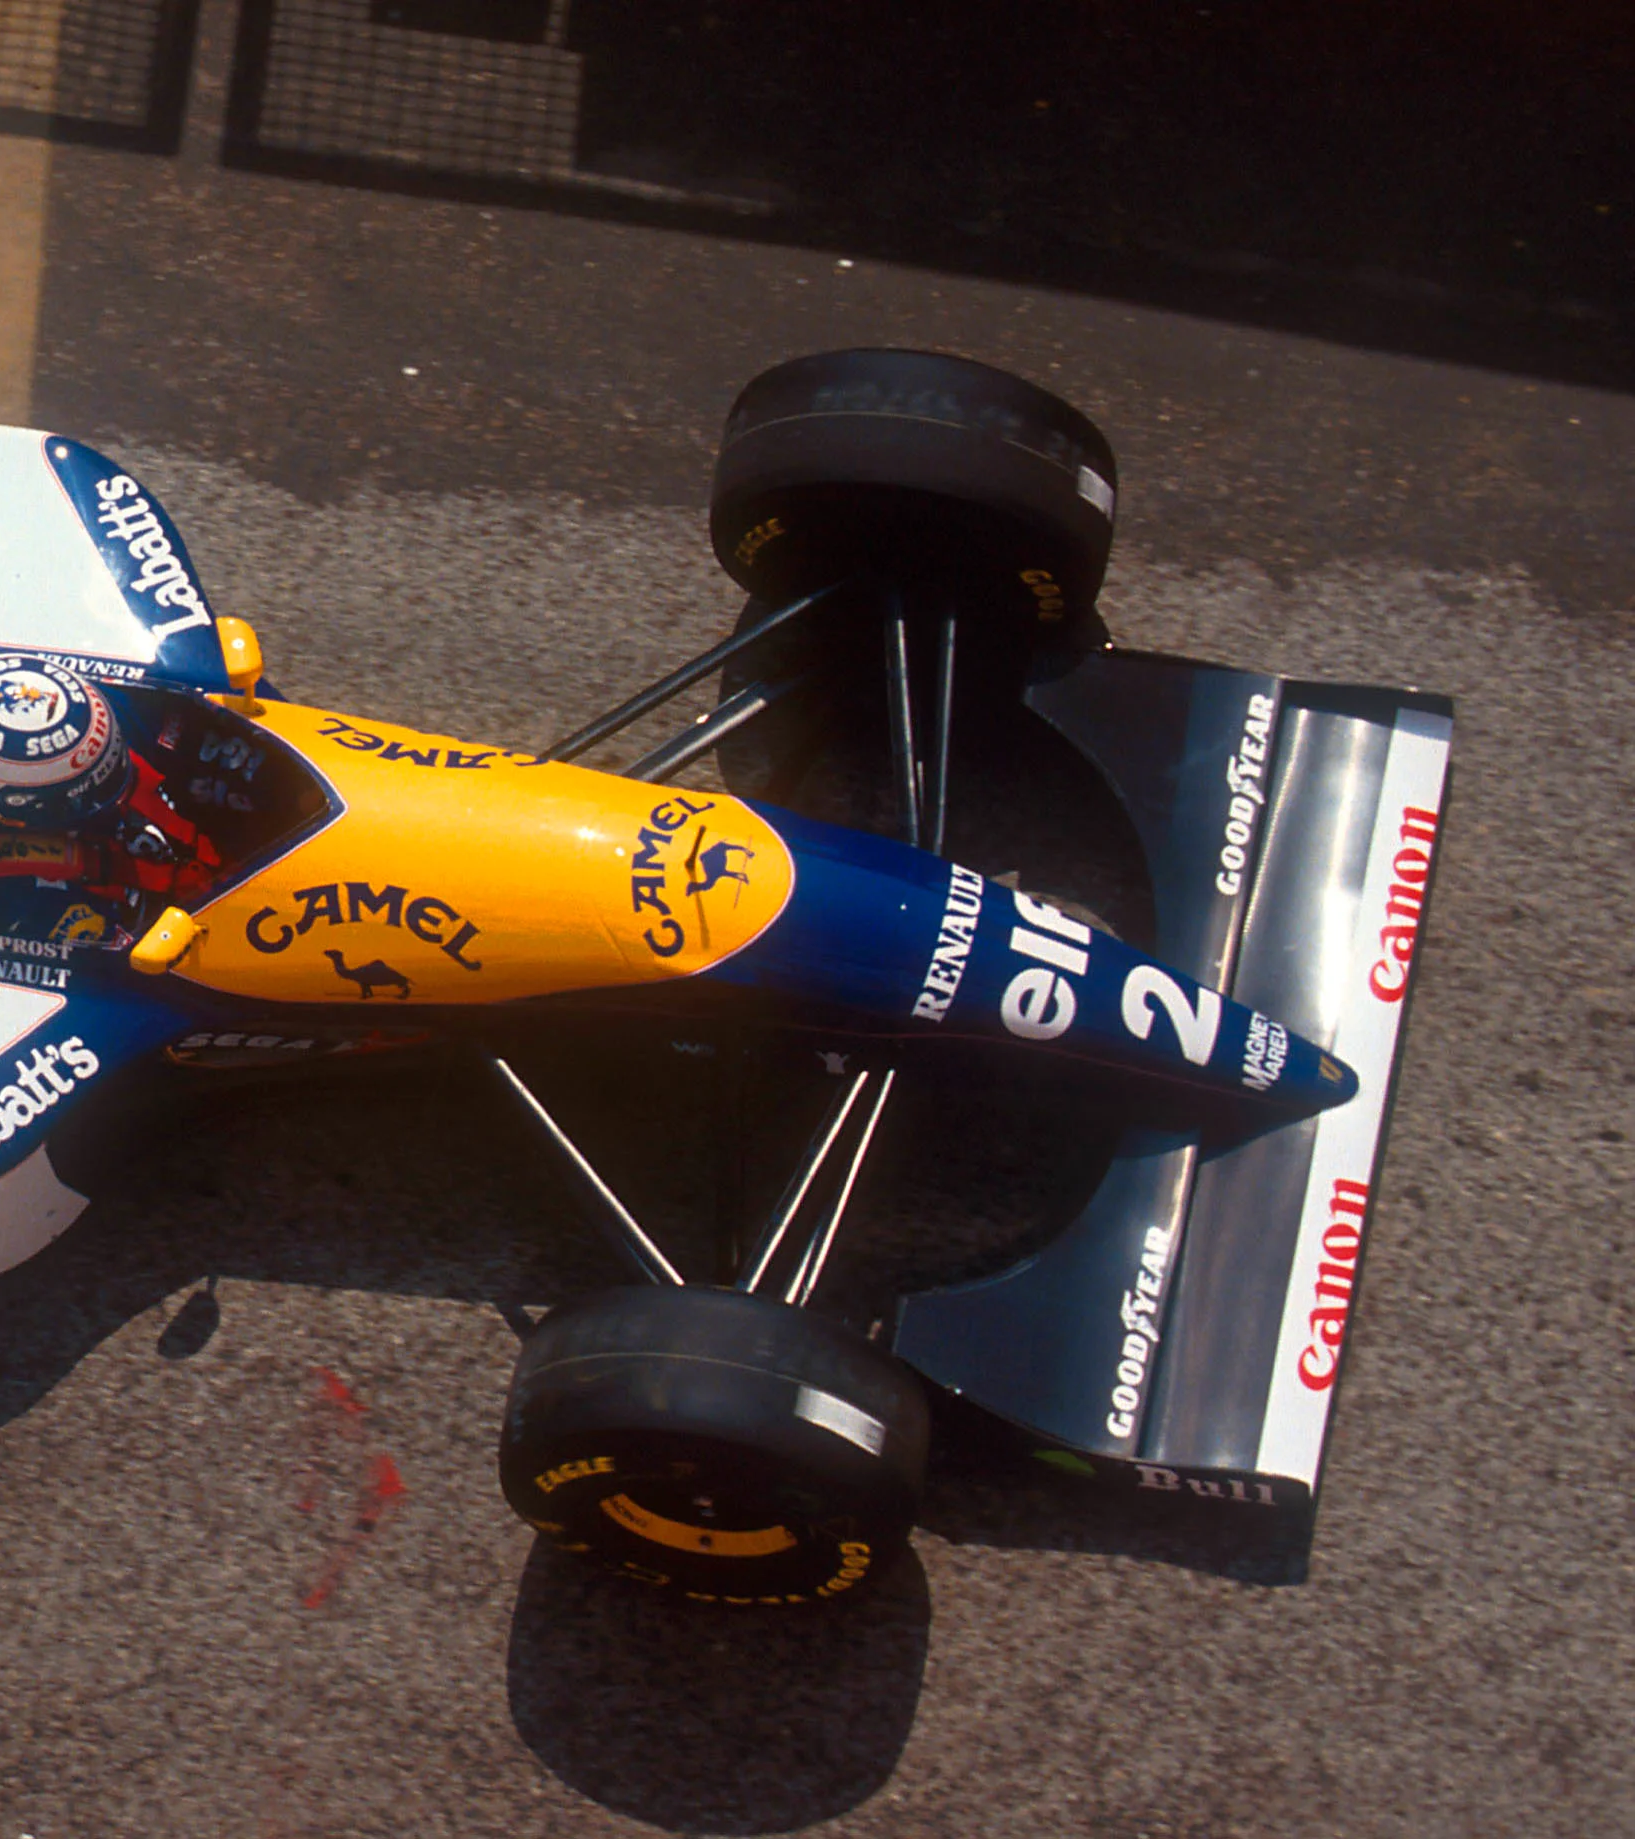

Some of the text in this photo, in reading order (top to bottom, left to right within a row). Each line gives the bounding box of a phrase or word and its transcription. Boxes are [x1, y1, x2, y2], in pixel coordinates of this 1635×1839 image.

[95, 474, 213, 640] Labatt's
[25, 723, 80, 757] SEGA
[43, 663, 86, 704] SEGA
[315, 717, 550, 769] CAMEL
[1216, 693, 1275, 896] GOODYEAR
[245, 882, 483, 972] CAMEL
[631, 797, 716, 958] CAMEL
[1369, 804, 1440, 1004] Canon
[1000, 888, 1092, 1041] elf
[1121, 964, 1223, 1067] 2
[1106, 1225, 1171, 1439] GOODYEAR
[1297, 1177, 1369, 1392] Canon
[1135, 1463, 1277, 1506] Bull
